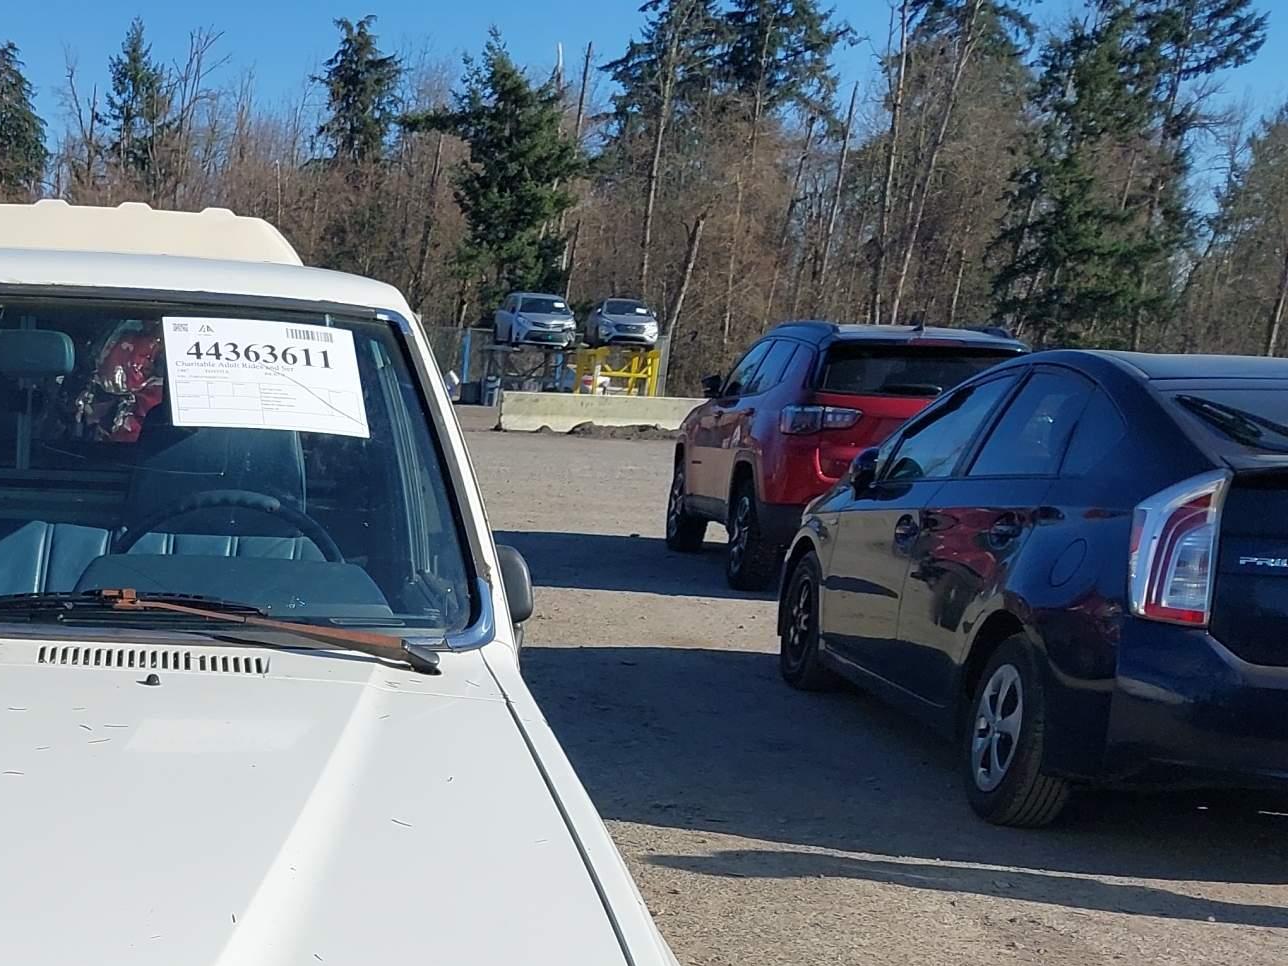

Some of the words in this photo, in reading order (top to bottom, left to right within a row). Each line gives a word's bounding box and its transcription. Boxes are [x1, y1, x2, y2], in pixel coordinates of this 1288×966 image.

[186, 341, 334, 369] 44363611
[175, 360, 216, 368] Charitable
[218, 361, 239, 369] Adult
[242, 362, 264, 370] Rides
